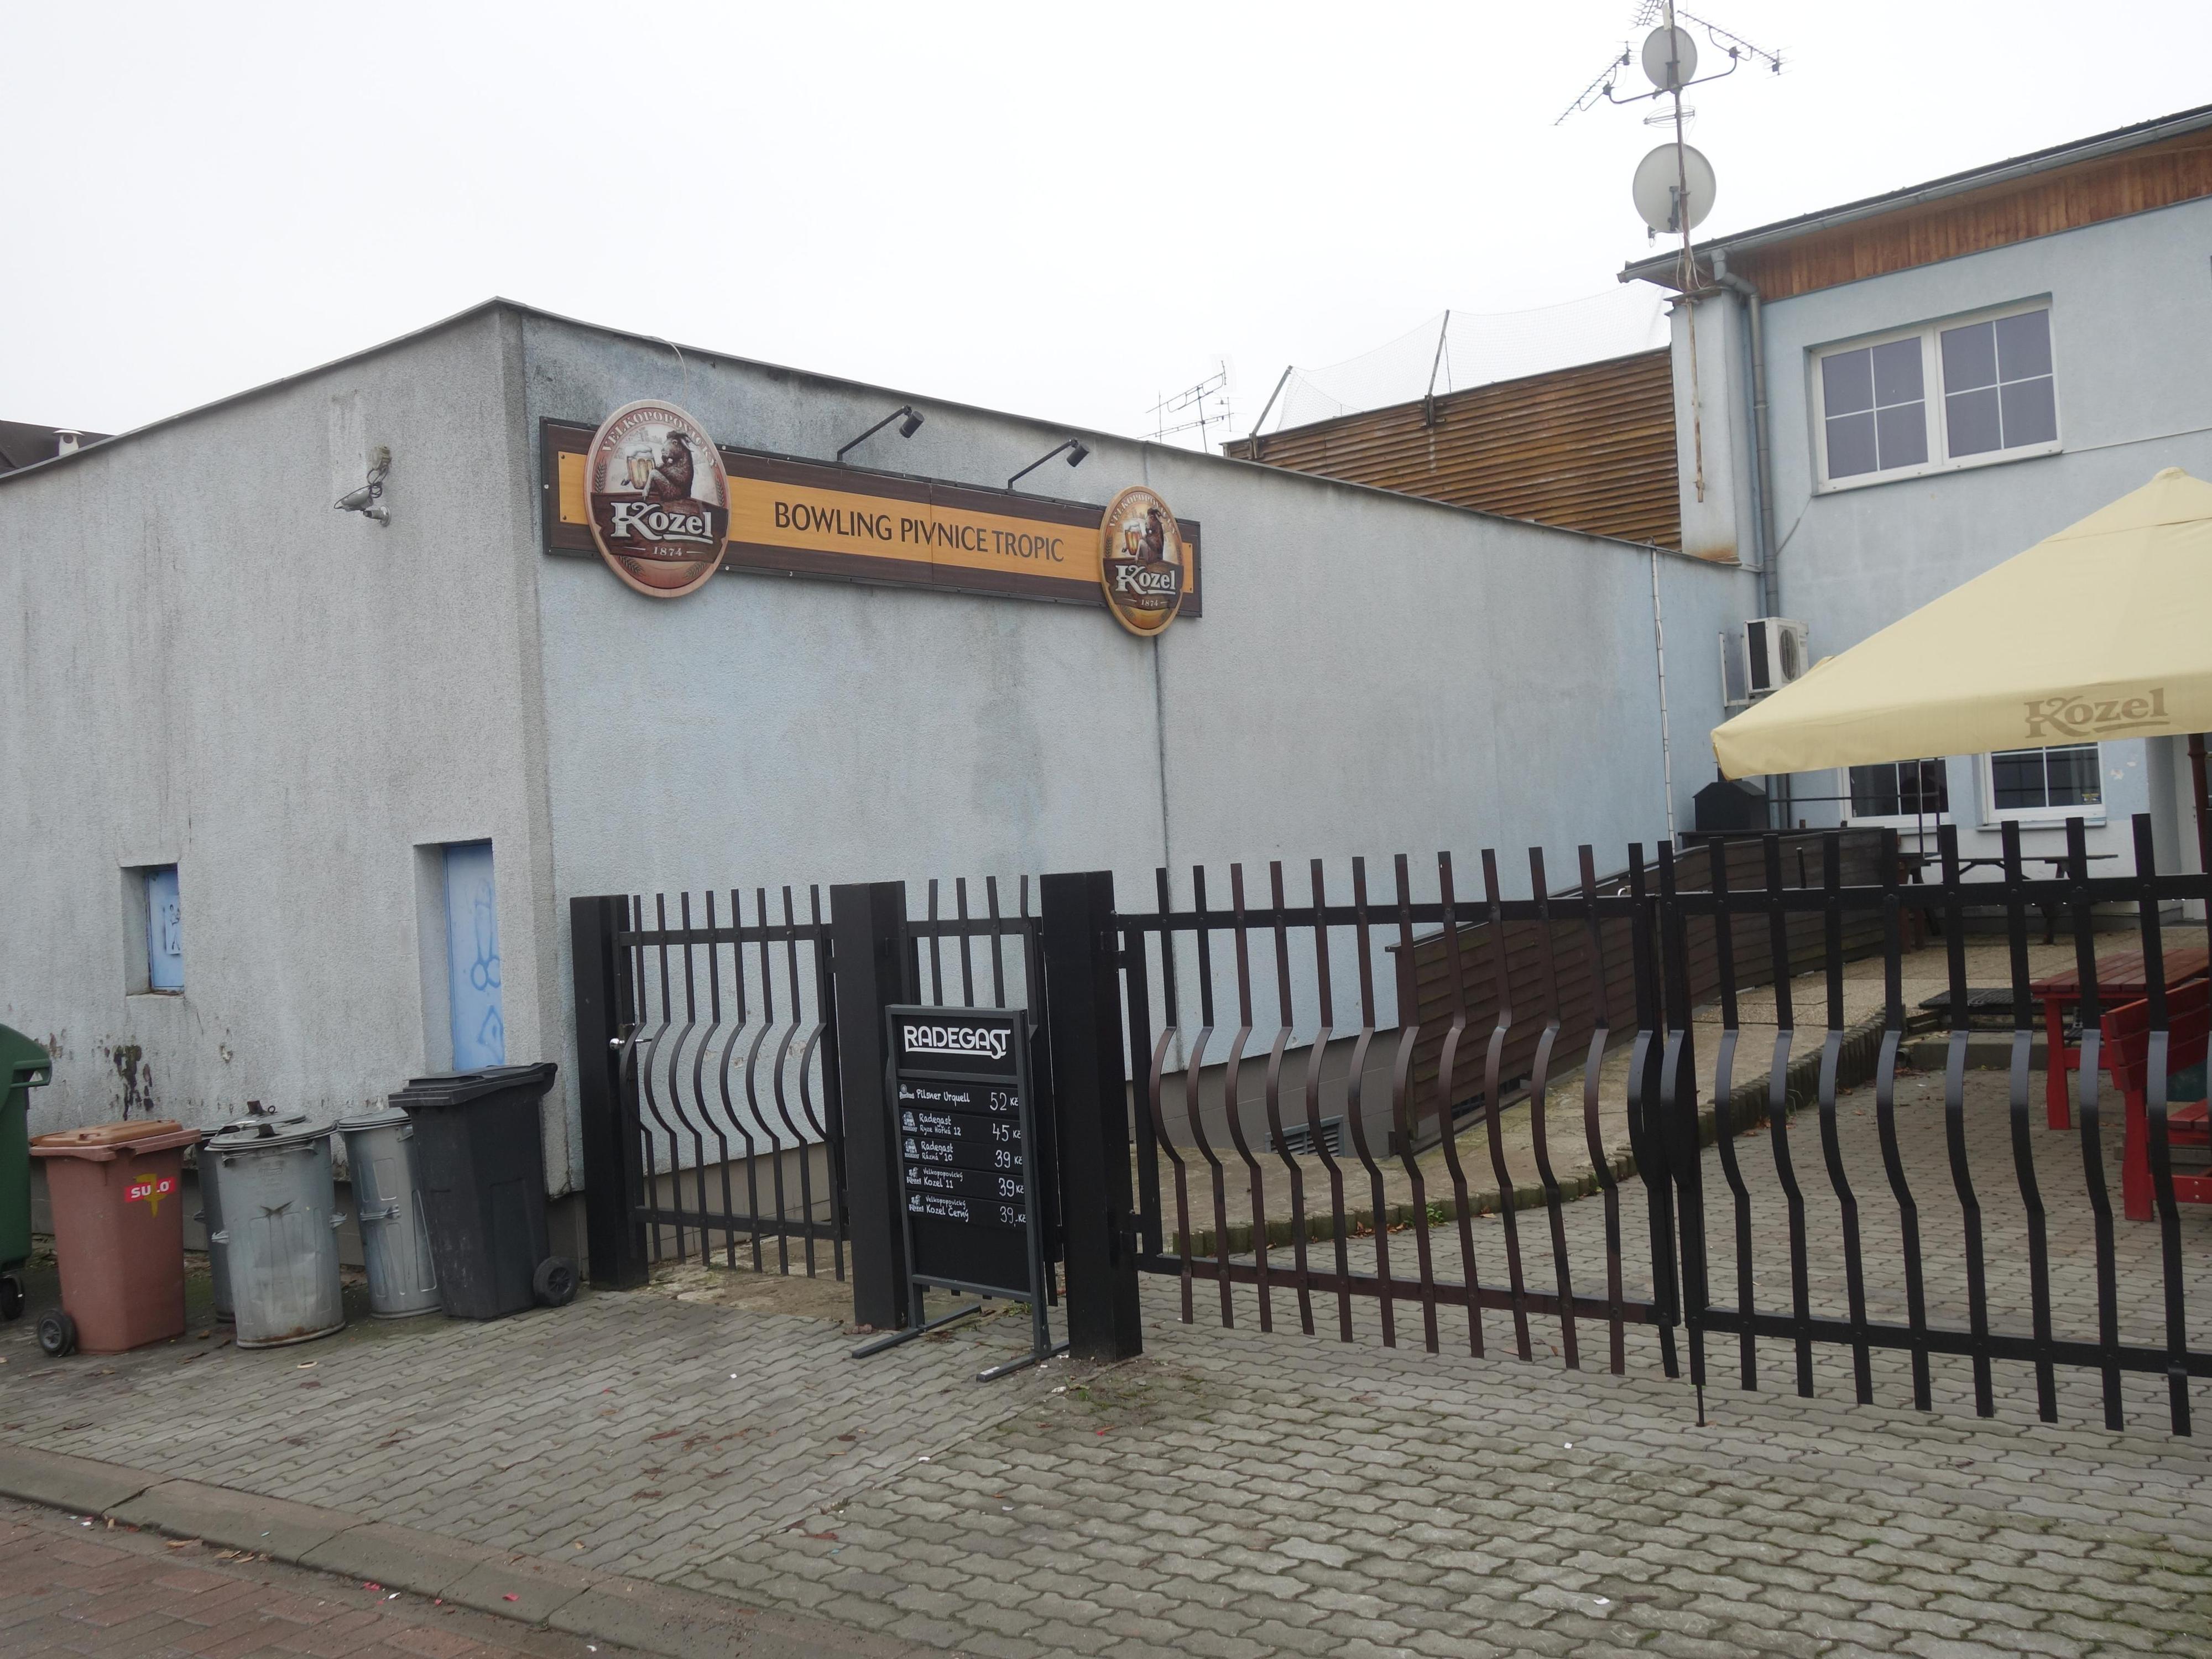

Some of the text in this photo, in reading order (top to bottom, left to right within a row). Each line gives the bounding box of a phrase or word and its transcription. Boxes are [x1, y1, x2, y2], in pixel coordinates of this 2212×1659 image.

[611, 502, 713, 544] Kozel
[775, 501, 1064, 562] BOWLING PIVNICE TROPIC
[653, 546, 682, 557] 1874
[1115, 565, 1176, 595] Kozel
[2023, 687, 2170, 738] Kozel
[904, 1025, 1011, 1060] RADEGAST
[916, 1088, 941, 1100] Pilsner
[943, 1091, 971, 1107] Urquell
[989, 1092, 1019, 1111] 52 Kč
[919, 1112, 952, 1128] Radegast
[935, 1125, 951, 1135] Hořká
[953, 1126, 962, 1136] 12
[992, 1123, 1021, 1142] 45 Kč
[921, 1140, 953, 1155] Radegast
[921, 1151, 939, 1160] Rázná
[944, 1153, 953, 1162] 10
[994, 1150, 1022, 1168] 39 Kč
[923, 1167, 963, 1182] Velkopopovický
[924, 1176, 954, 1188] Kozel 11
[131, 1181, 169, 1198] SUO
[998, 1177, 1025, 1197] 39 Kč
[925, 1194, 966, 1210] Velkopopovický
[926, 1204, 969, 1223] Kozel Černý
